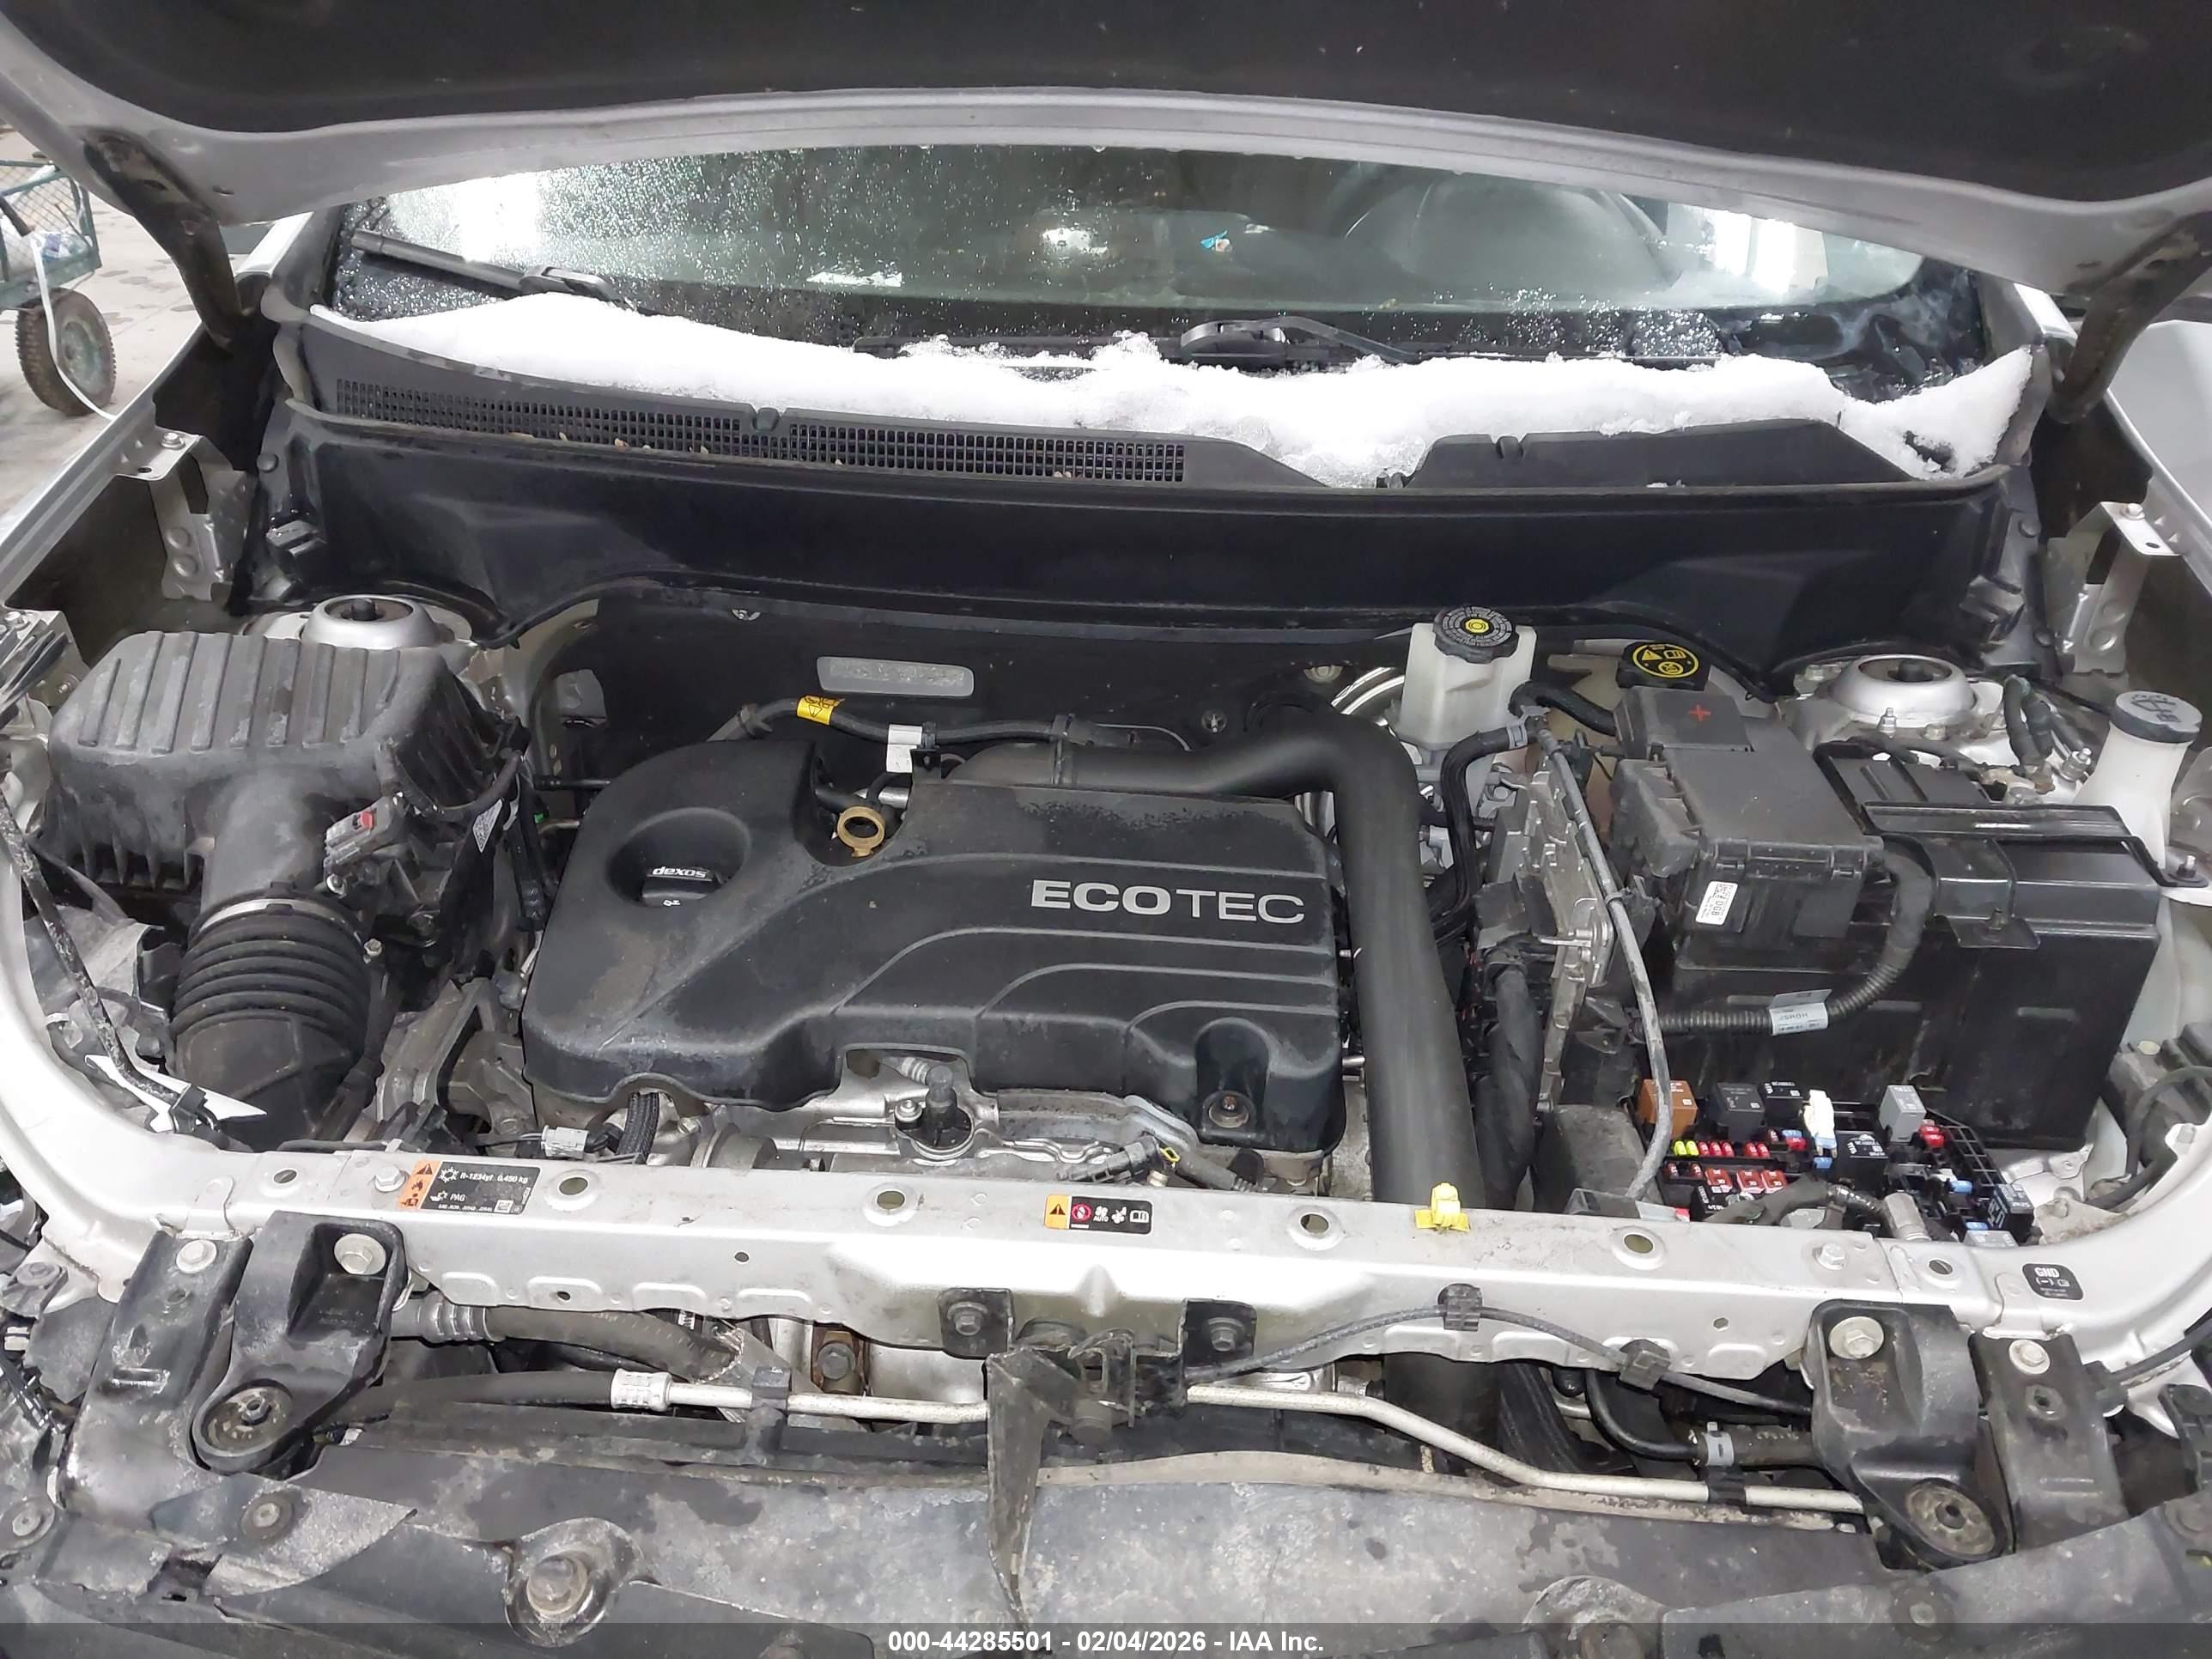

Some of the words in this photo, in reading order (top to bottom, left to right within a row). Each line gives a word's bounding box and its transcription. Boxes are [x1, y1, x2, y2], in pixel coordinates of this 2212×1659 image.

[653, 866, 708, 878] dexos
[1030, 878, 1305, 924] ECOTEC
[518, 1175, 529, 1184] kg
[450, 1193, 466, 1202] PAG
[2034, 1267, 2060, 1278] GND
